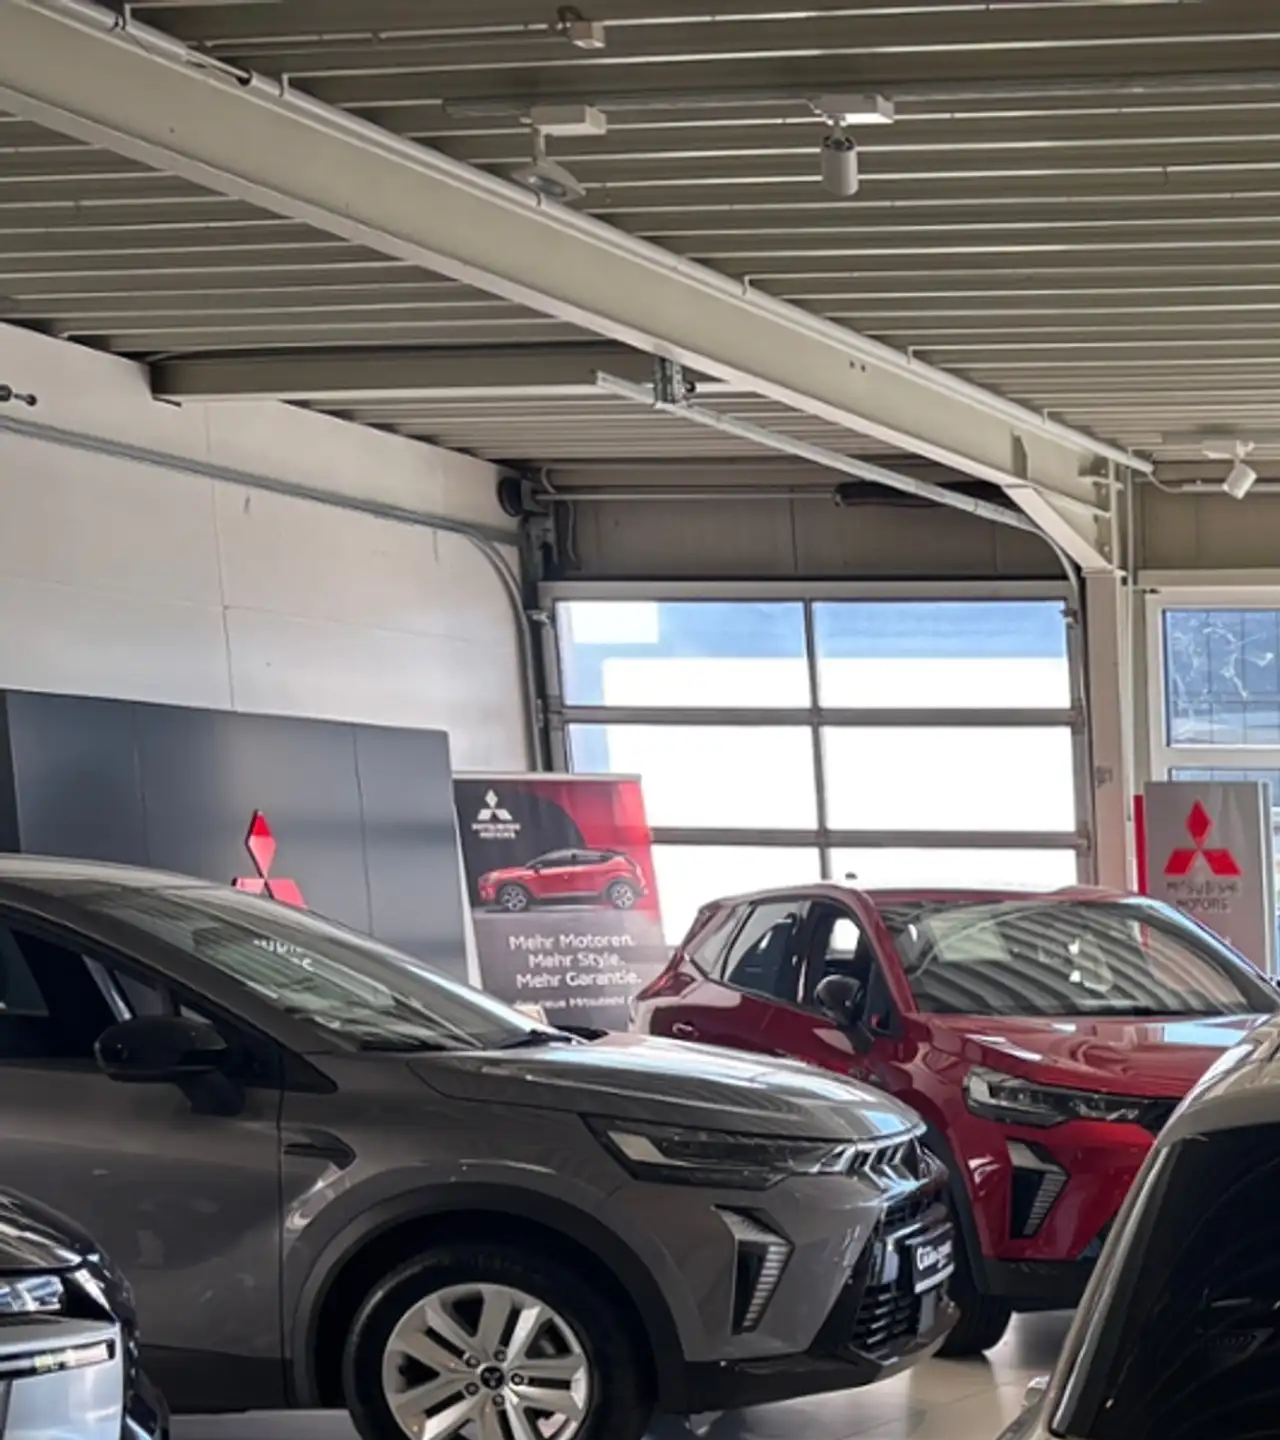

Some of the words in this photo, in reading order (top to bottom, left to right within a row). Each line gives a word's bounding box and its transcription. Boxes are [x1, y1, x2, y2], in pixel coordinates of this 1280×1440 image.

[509, 935, 553, 950] Mehr
[559, 933, 636, 949] Motoren.
[528, 952, 573, 968] Mehr
[577, 951, 626, 968] Style.
[516, 972, 561, 988] Mehr
[566, 970, 642, 986] Garantie.
